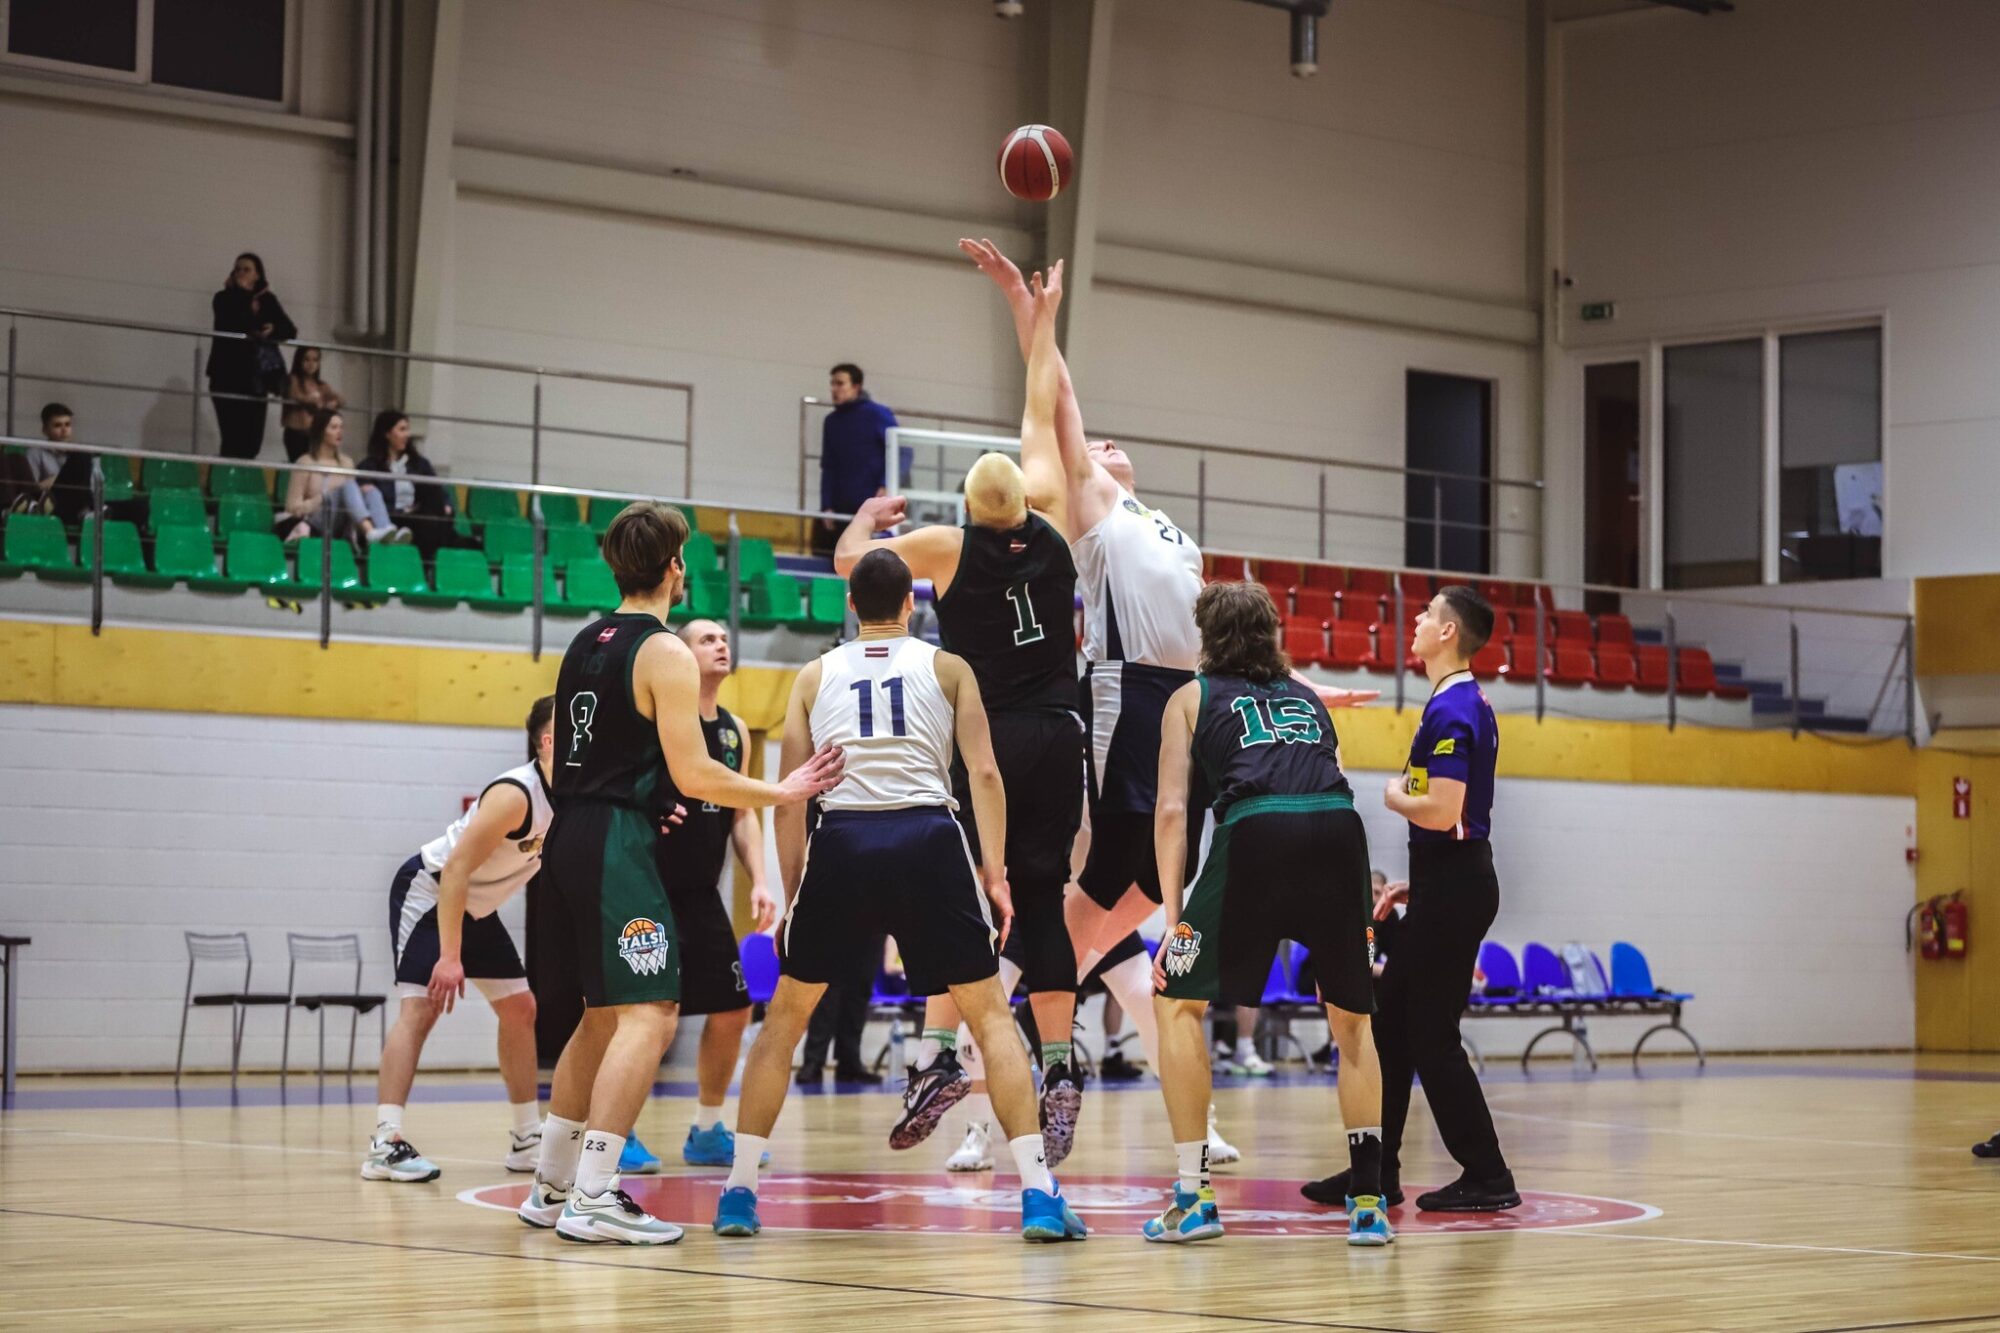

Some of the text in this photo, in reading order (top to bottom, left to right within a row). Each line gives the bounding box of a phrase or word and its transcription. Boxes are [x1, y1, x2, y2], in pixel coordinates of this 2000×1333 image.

[1154, 518, 1183, 546] 27
[1006, 582, 1045, 646] 1
[850, 676, 906, 738] 11
[1230, 695, 1322, 749] 15
[620, 932, 663, 950] TALSI
[585, 1139, 607, 1152] 23
